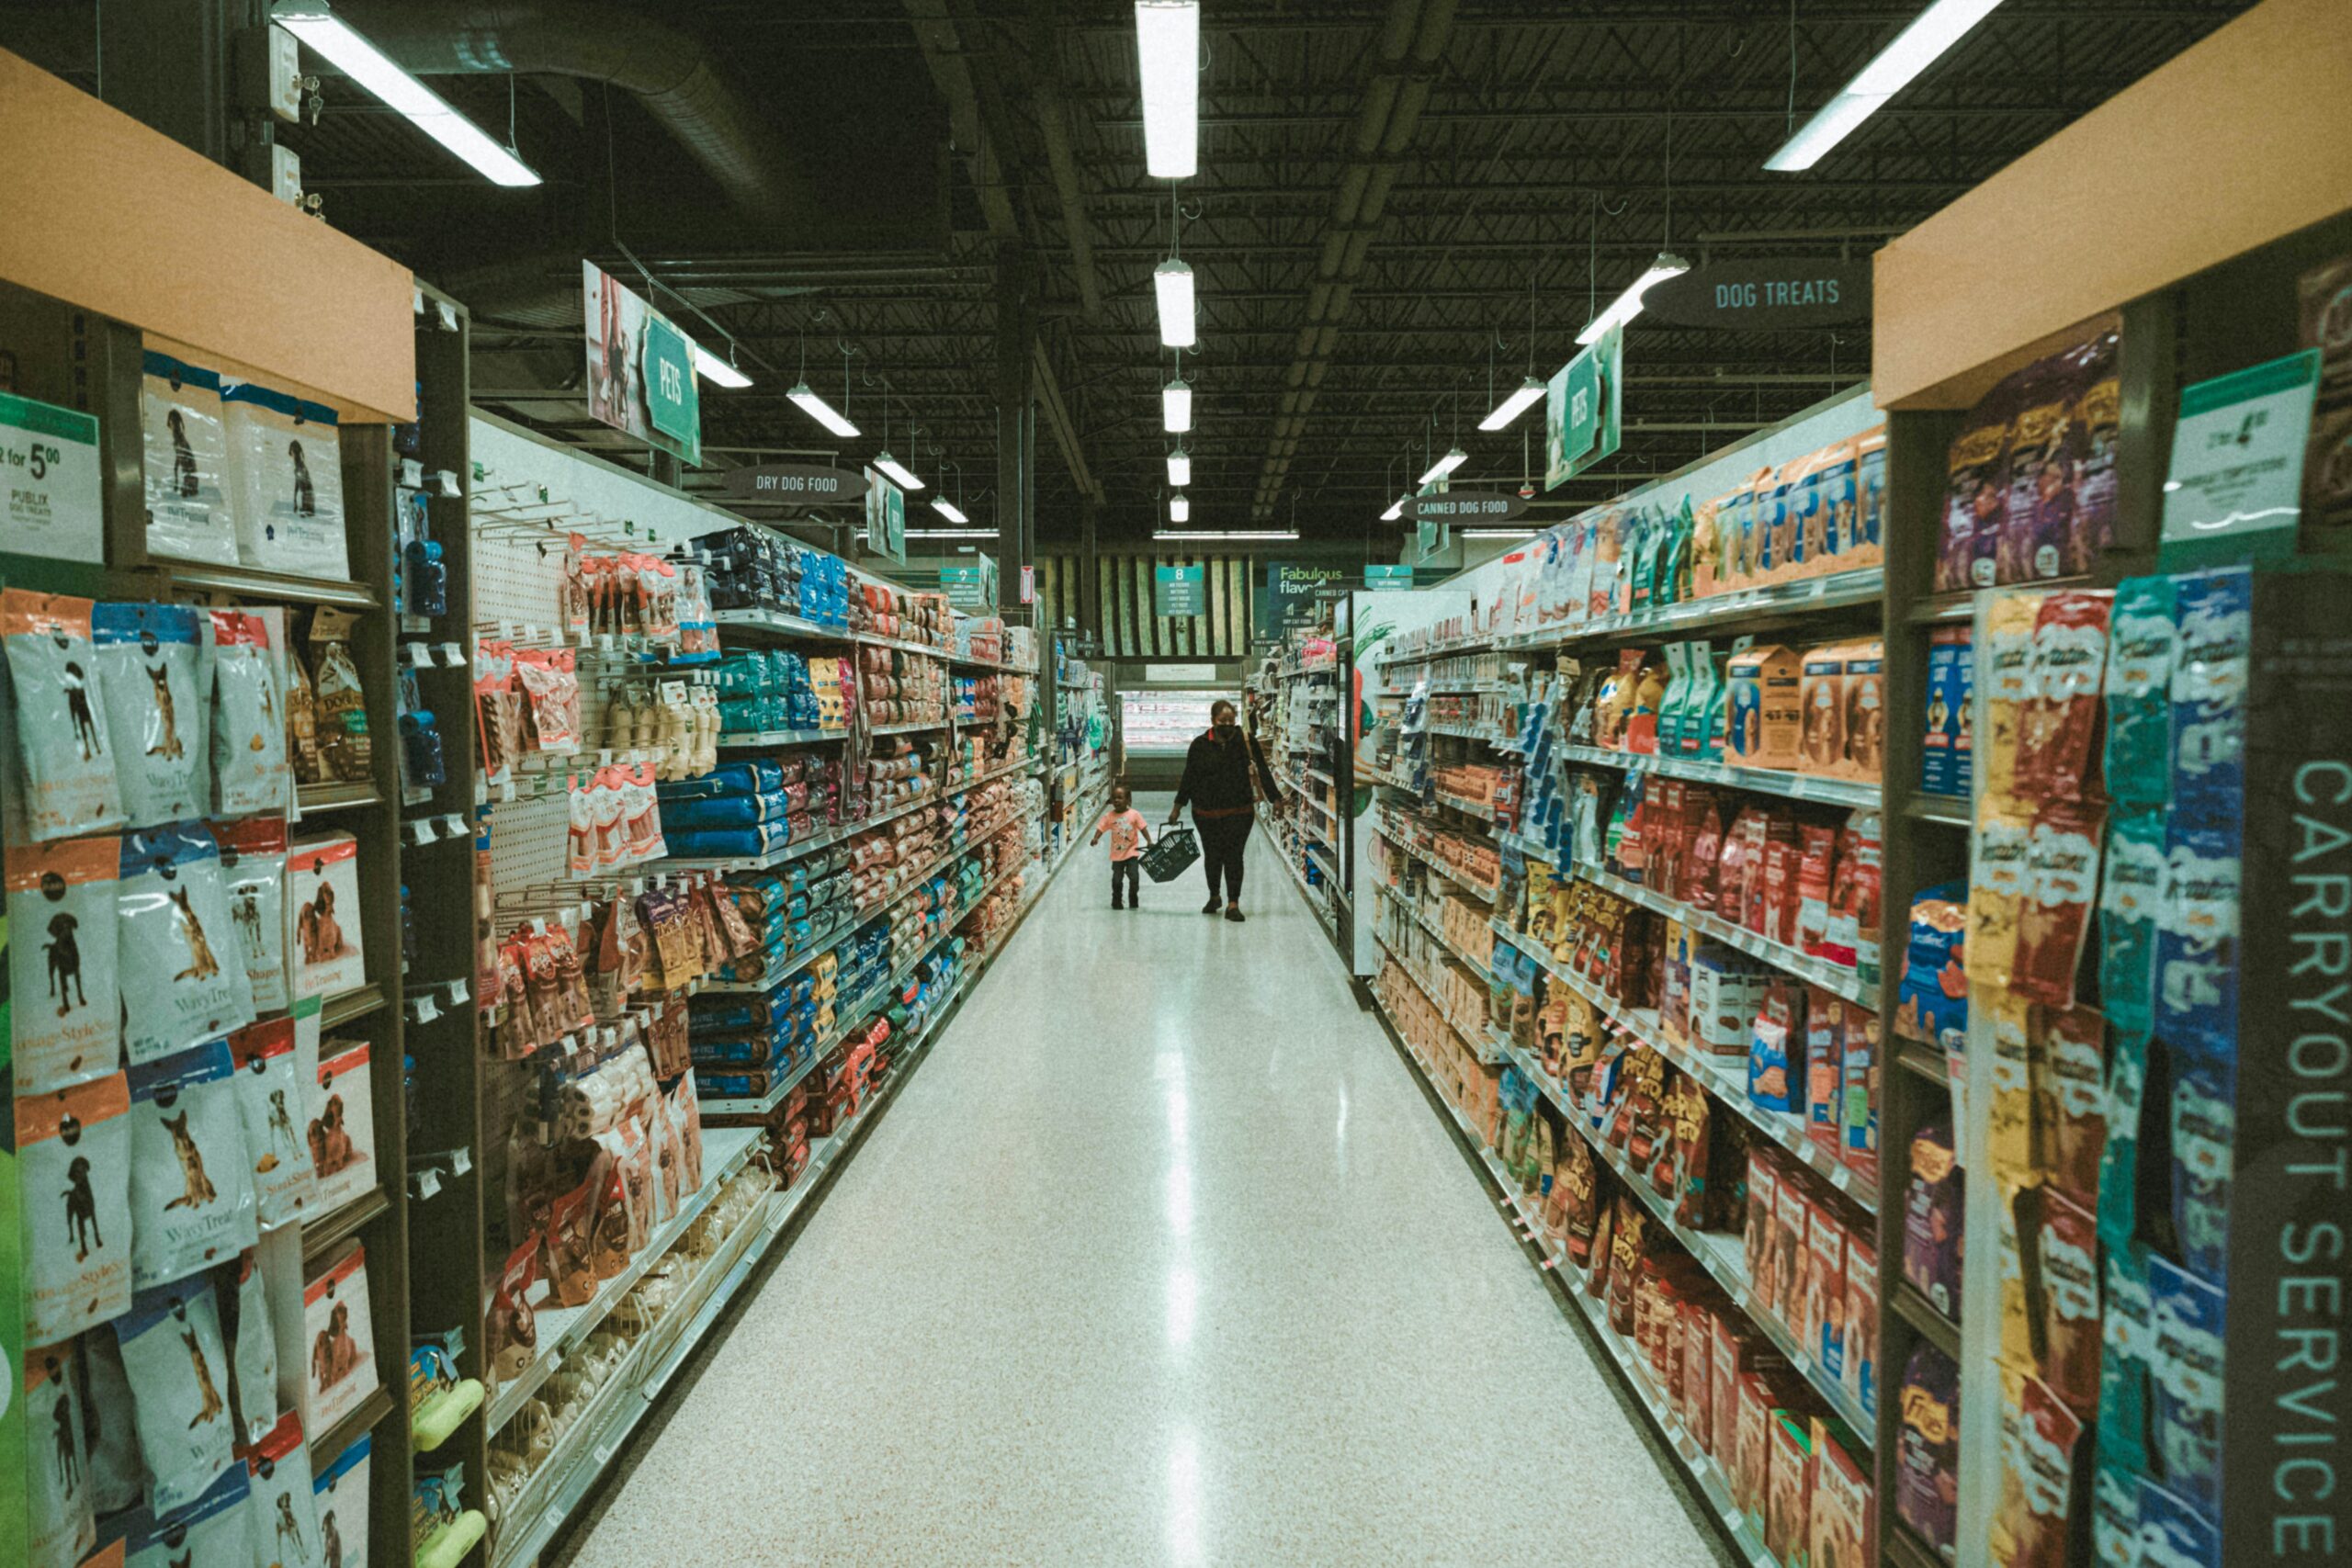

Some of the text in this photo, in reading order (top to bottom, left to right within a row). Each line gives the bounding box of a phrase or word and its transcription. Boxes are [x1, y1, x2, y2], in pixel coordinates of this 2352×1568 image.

[1715, 278, 1839, 309] DOG TREATS
[660, 356, 682, 405] PETS
[1572, 387, 1588, 429] PETS
[8, 449, 26, 466] for
[756, 475, 838, 492] DRY DOG FOOD
[11, 489, 48, 505] PUBLIX
[1417, 500, 1508, 515] CANNED DOG FOOD
[959, 570, 967, 581] 9
[1176, 569, 1183, 580] 8
[1280, 567, 1342, 581] Fabulous
[1385, 567, 1393, 577] 7
[2273, 761, 2352, 1557] CARRYOUT SERVICE
